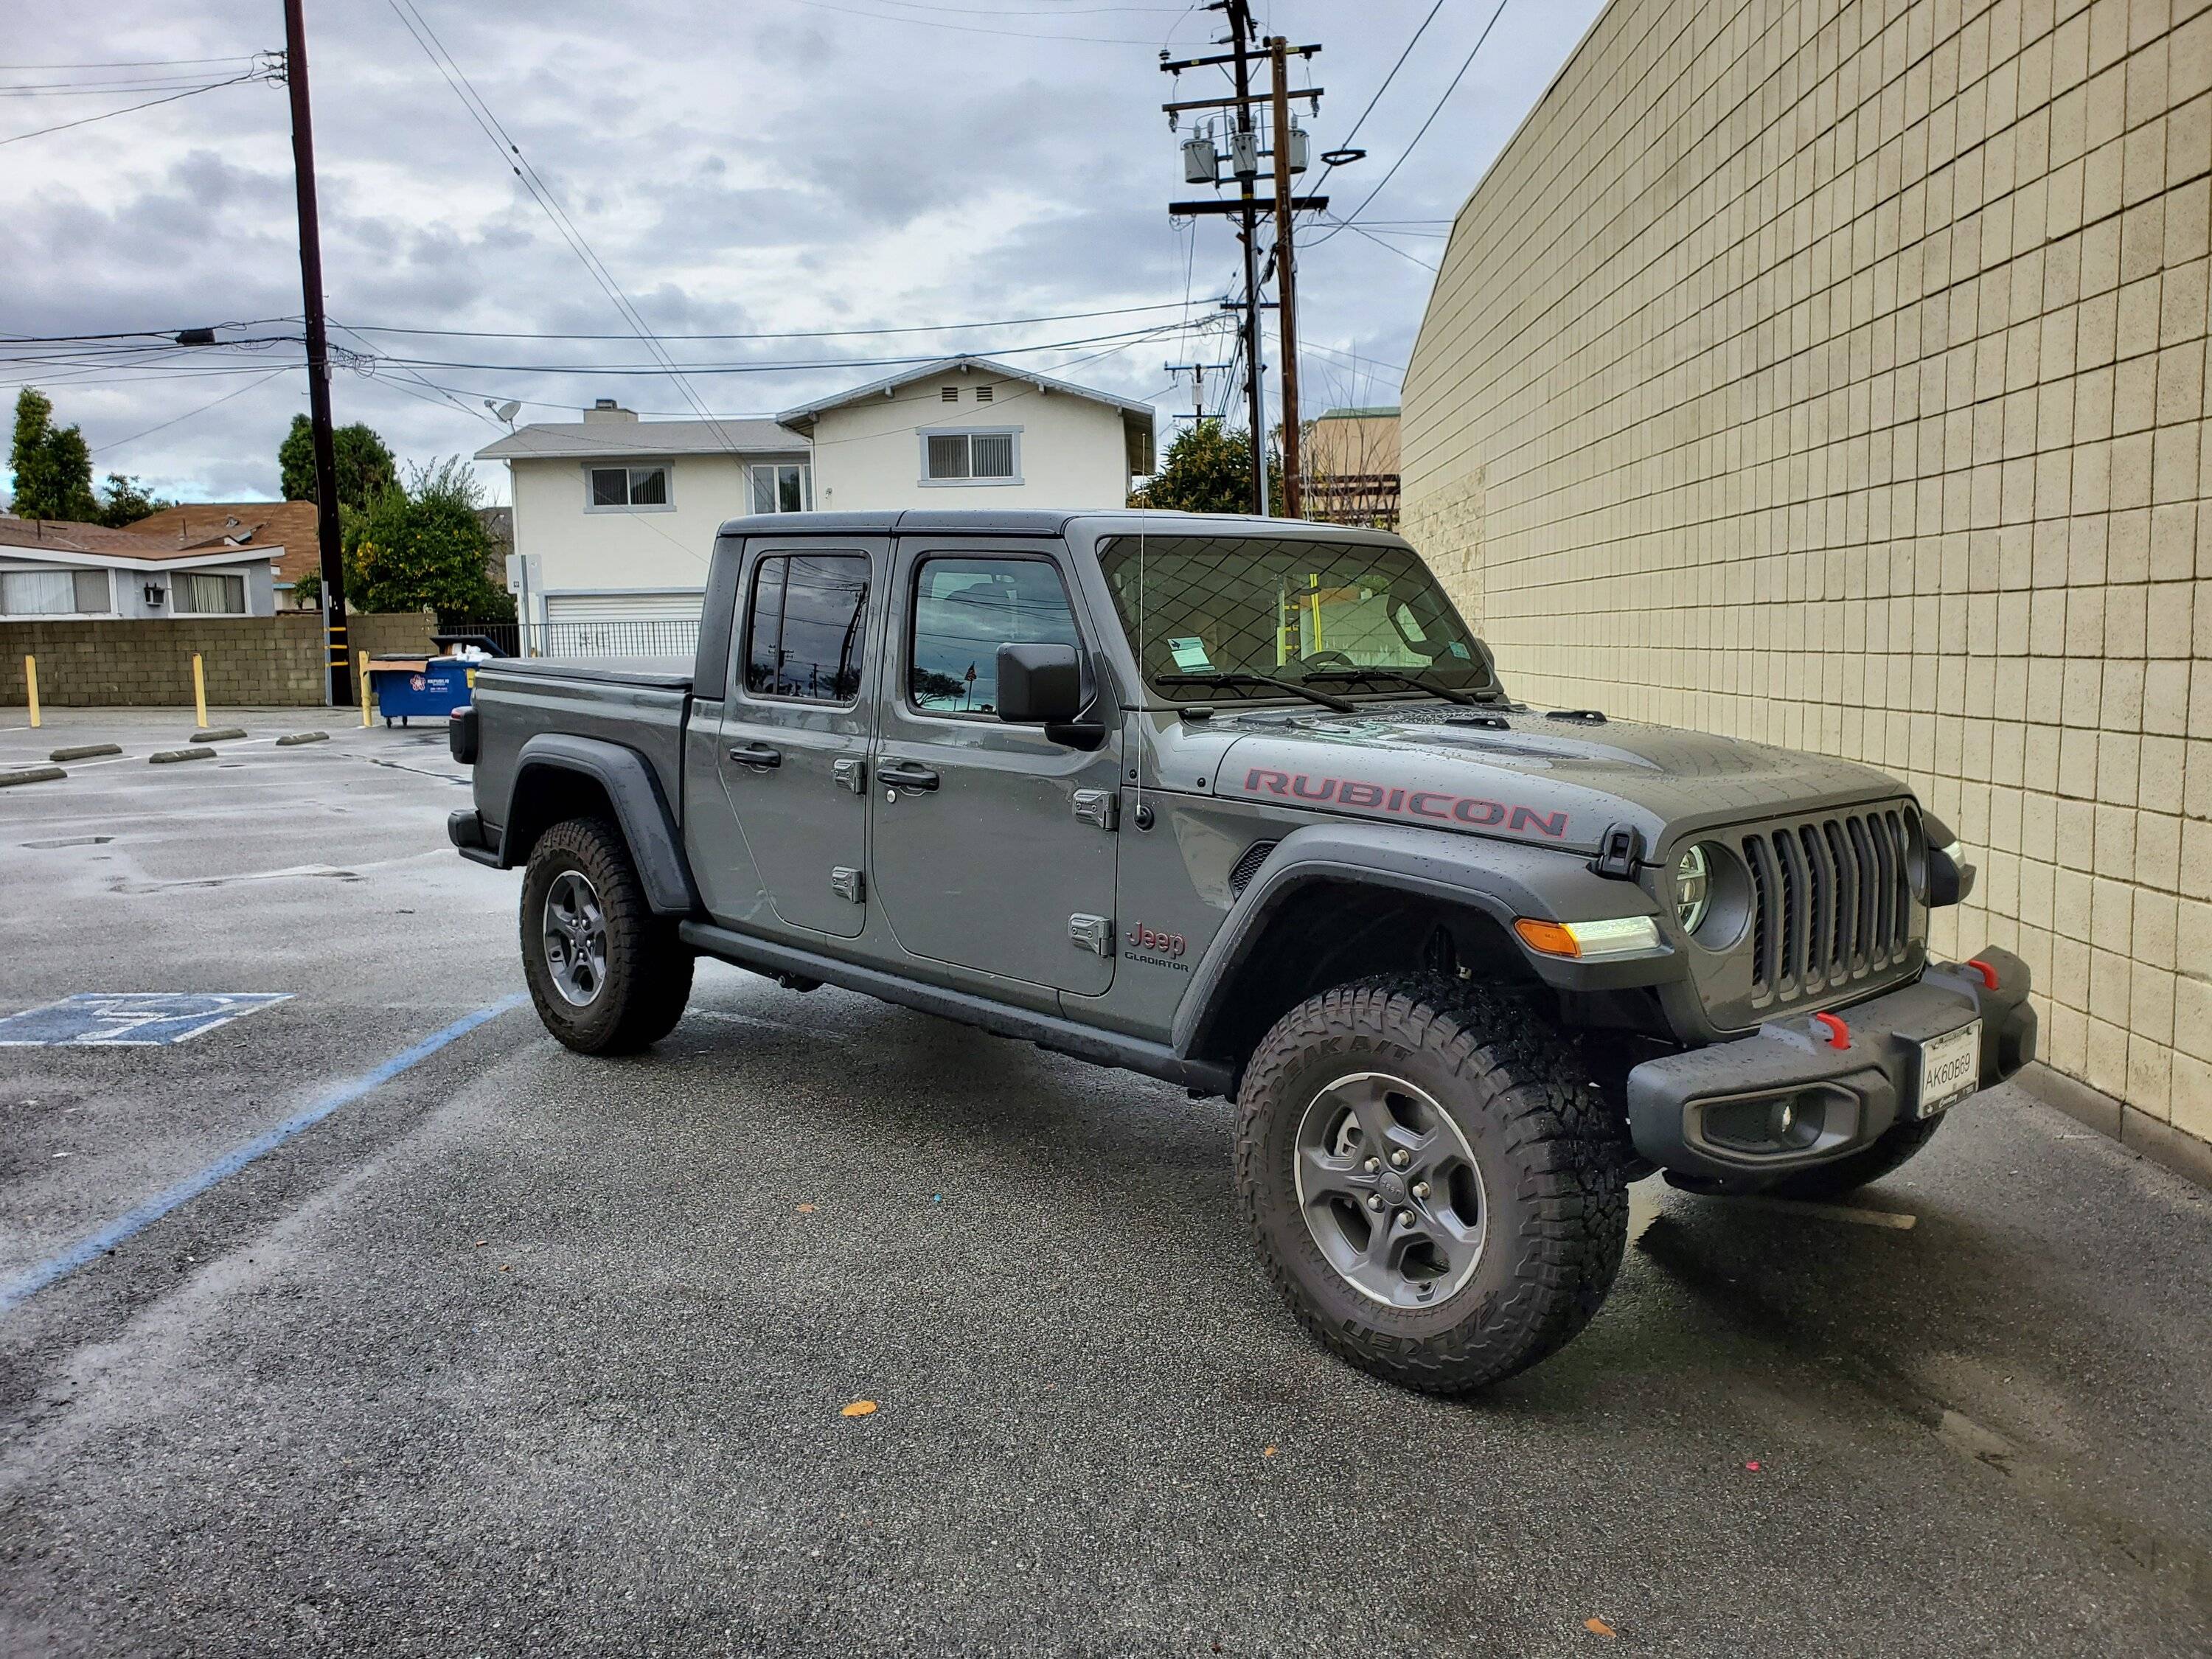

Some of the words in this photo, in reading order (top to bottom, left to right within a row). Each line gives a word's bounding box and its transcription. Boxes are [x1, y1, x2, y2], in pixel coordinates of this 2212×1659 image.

[1245, 768, 1568, 838] RUBICON
[1125, 921, 1186, 960] Jeep
[1125, 951, 1189, 972] GLADIATOR
